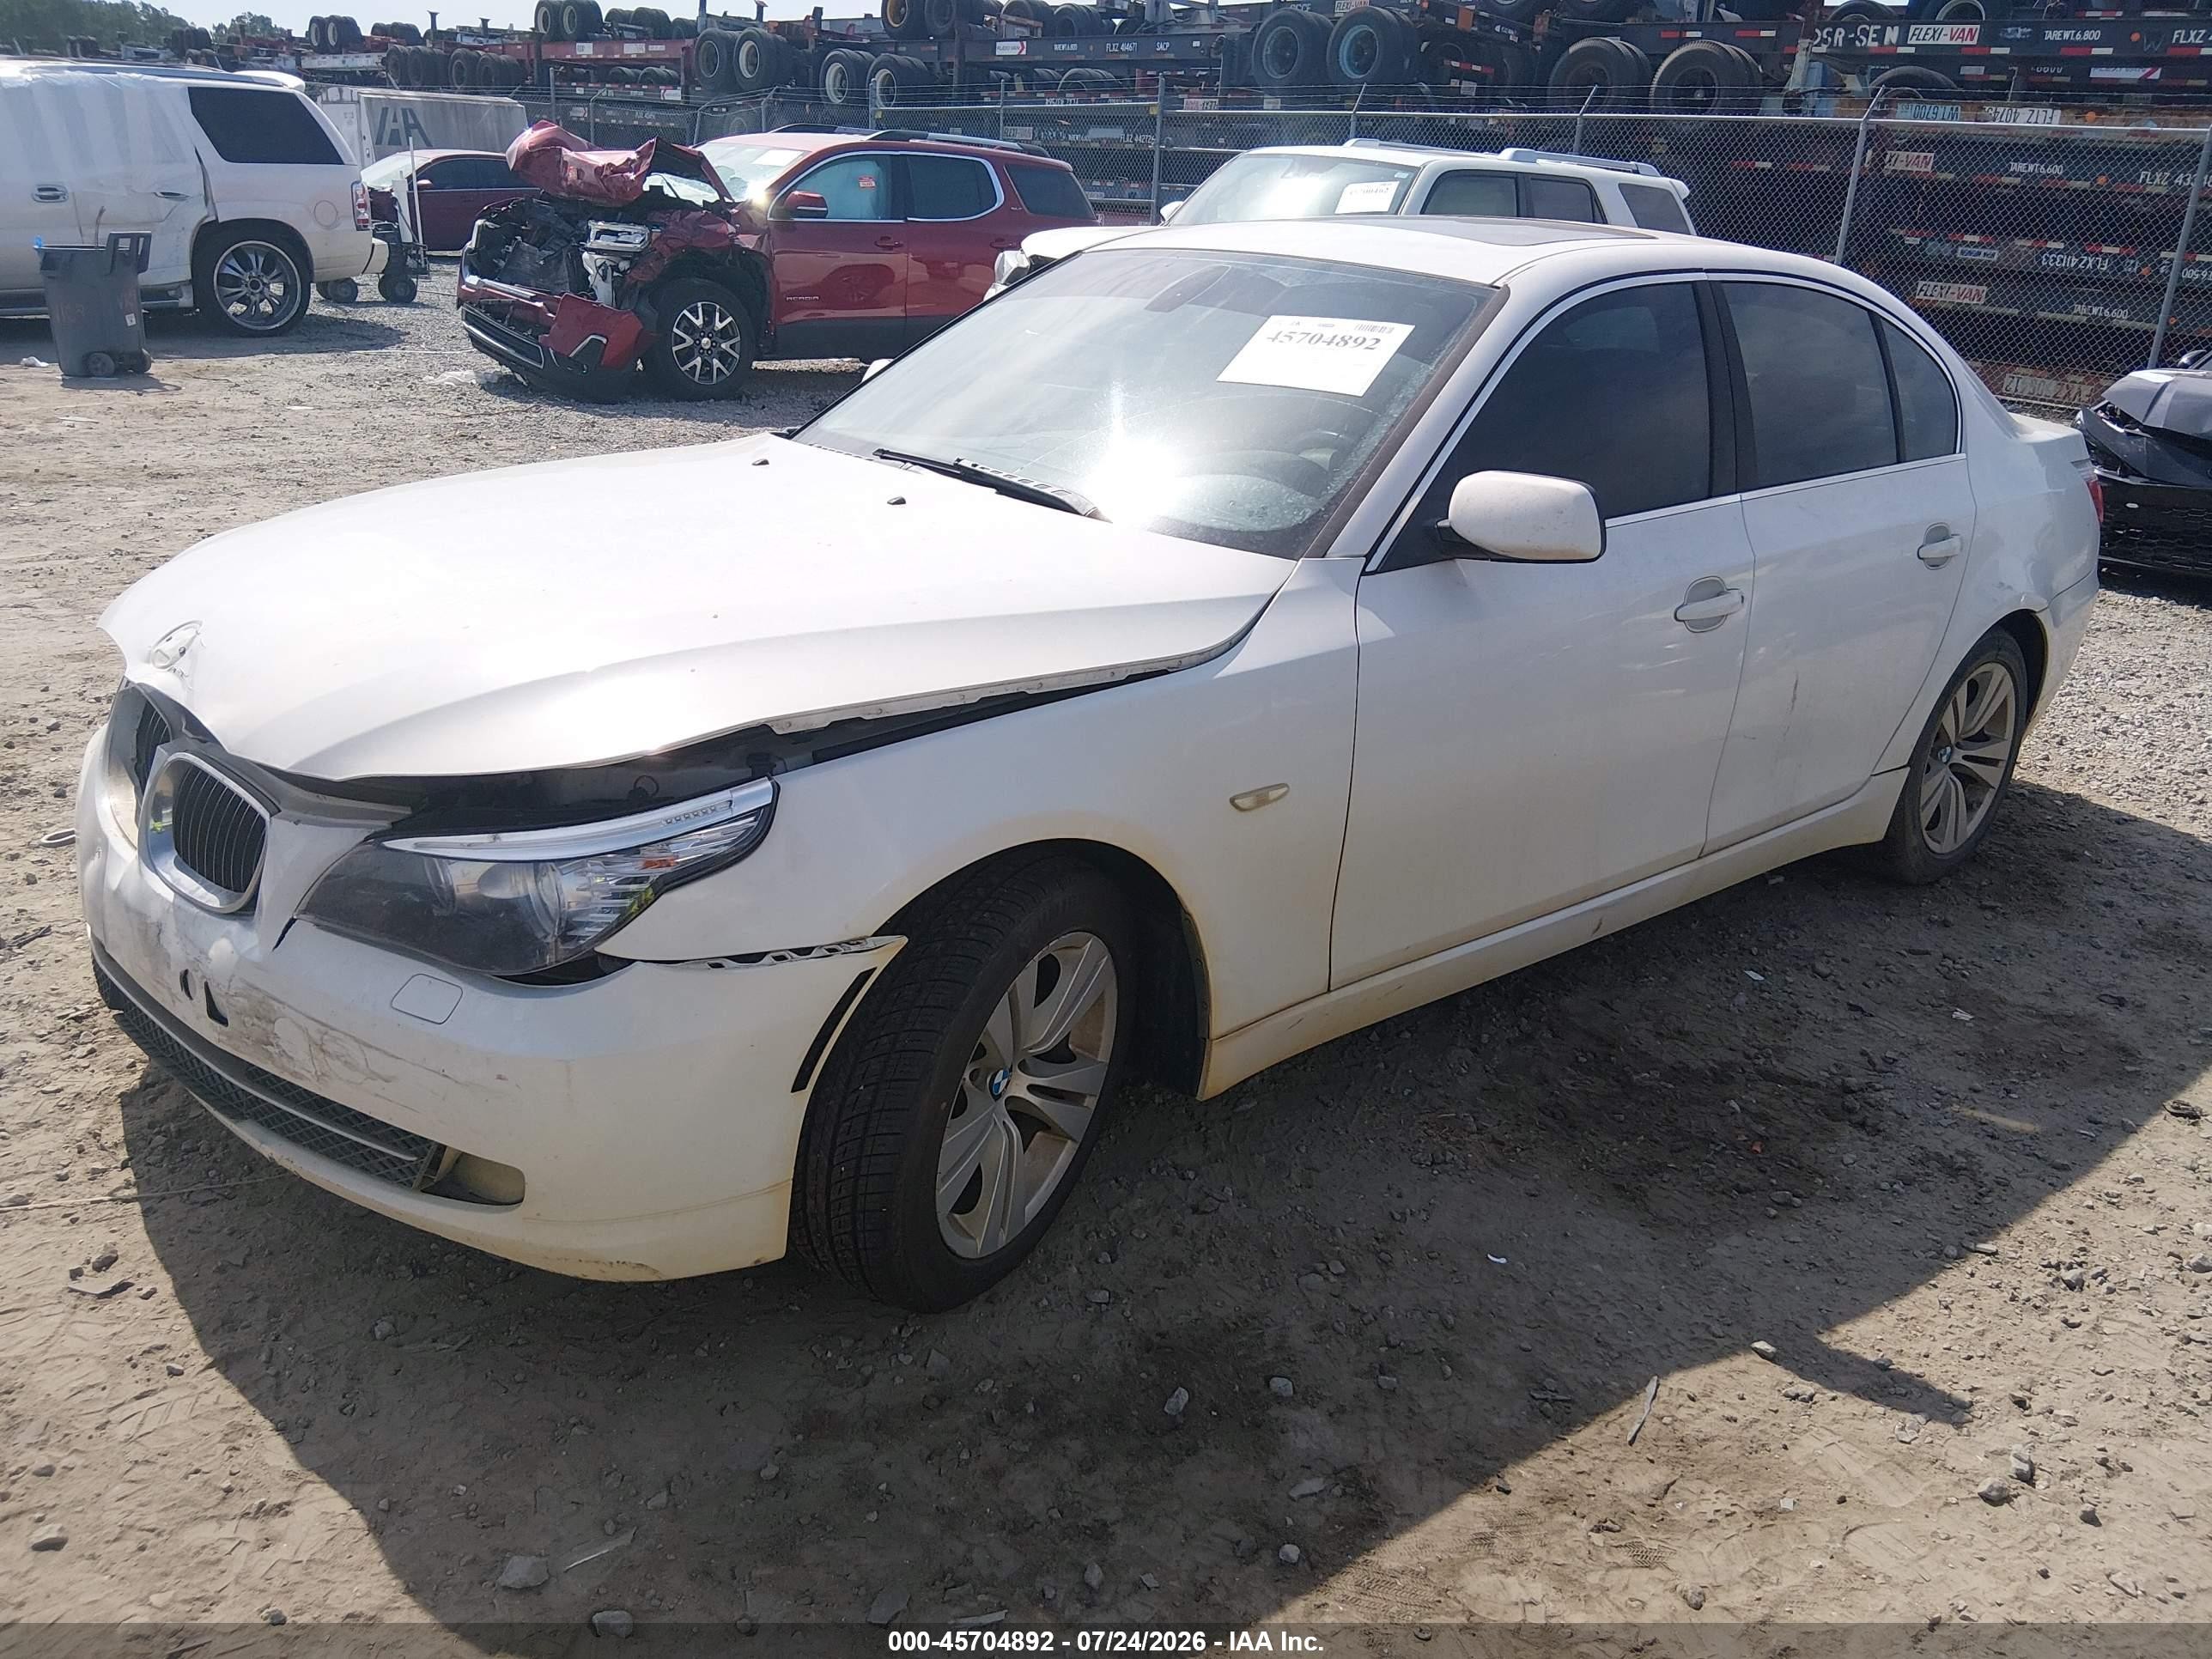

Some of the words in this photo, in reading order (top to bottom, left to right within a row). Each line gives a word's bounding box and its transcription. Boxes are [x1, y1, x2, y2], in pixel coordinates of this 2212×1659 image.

[1910, 27, 1978, 41] FLEXI-VAN
[2172, 29, 2206, 43] FLXZ
[2026, 109, 2054, 125] FLTZ
[375, 107, 433, 147] IAA
[2139, 171, 2171, 185] FLXZ
[1917, 283, 1985, 302] FLEXI-VAN
[1267, 330, 1382, 350] 45704892
